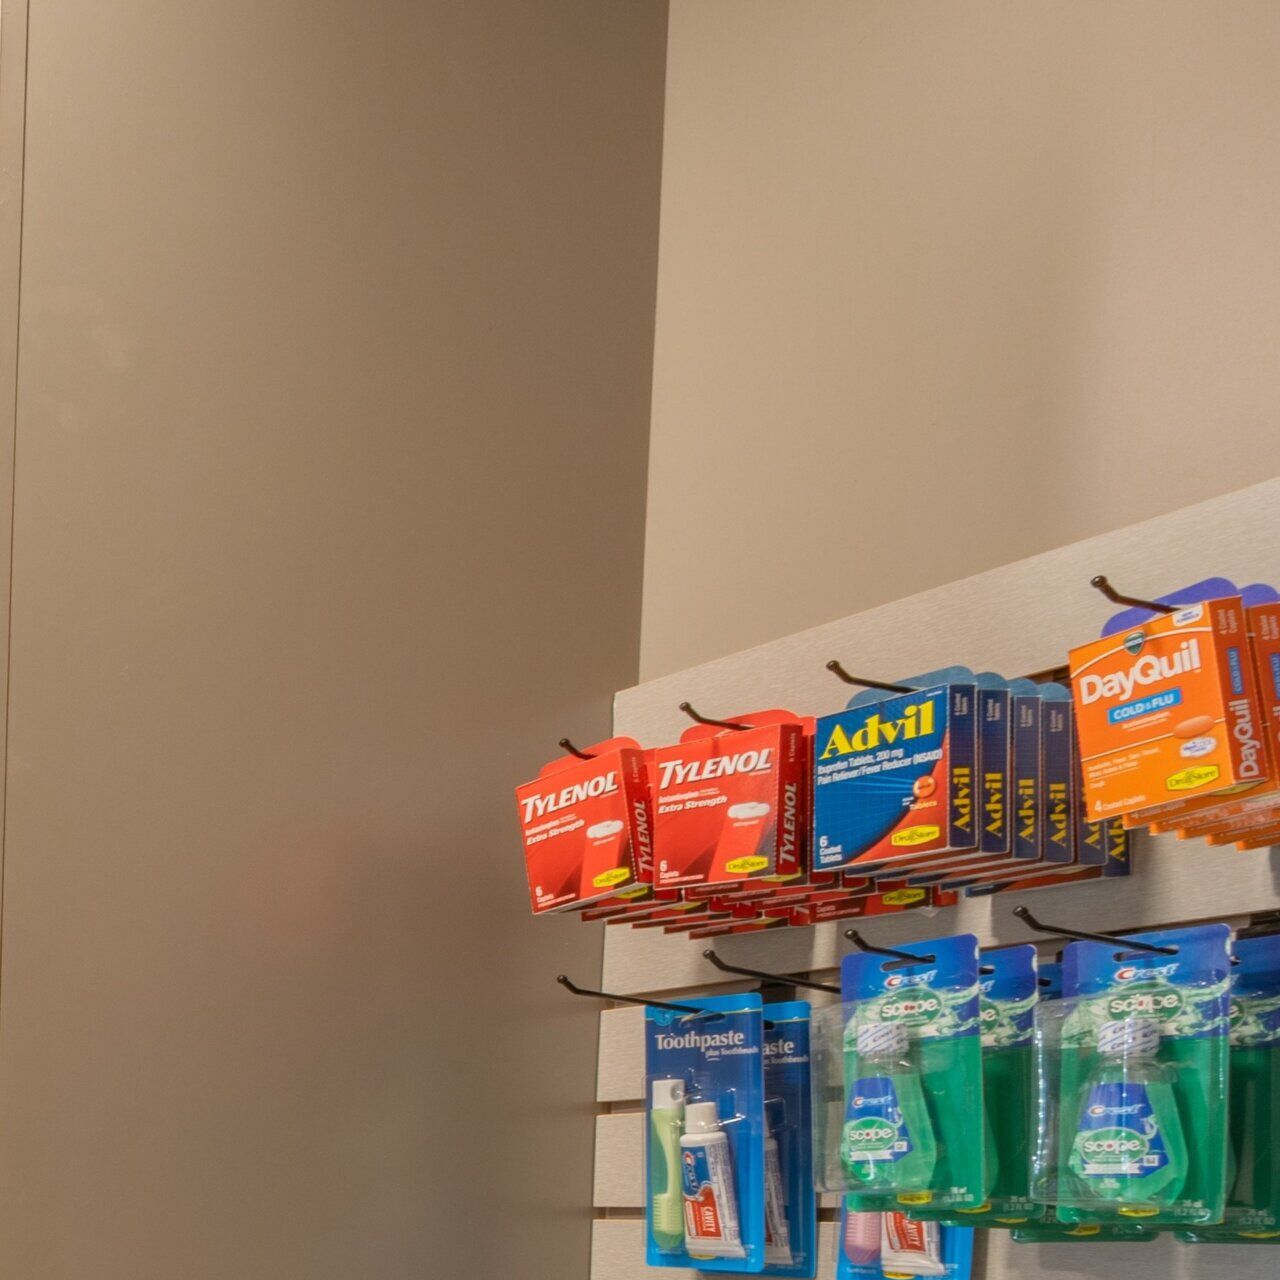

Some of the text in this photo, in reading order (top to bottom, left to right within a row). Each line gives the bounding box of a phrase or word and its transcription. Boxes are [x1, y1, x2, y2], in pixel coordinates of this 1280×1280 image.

[1079, 638, 1202, 706] DayQuil
[819, 700, 935, 760] Advil
[1228, 698, 1260, 778] DayQuil
[658, 747, 775, 790] TYLENOL
[520, 771, 618, 824] TYLENOL
[658, 795, 728, 814] Extra Strength
[953, 767, 971, 833] Advil
[985, 772, 1003, 838] Advil
[1094, 801, 1102, 812] 4
[1018, 778, 1035, 843] Advil
[1049, 783, 1067, 848] Advil
[526, 819, 585, 846] Extra Strength
[779, 783, 797, 864] TYLENOL
[633, 800, 654, 874] TYLENOL
[819, 835, 828, 847] 6
[660, 860, 667, 871] 6
[535, 886, 543, 897] 6
[884, 970, 938, 989] Crest
[1114, 962, 1180, 982] Crest
[880, 998, 939, 1017] scope
[1109, 992, 1181, 1016] scope
[655, 1030, 744, 1052] Toothpaste
[720, 1045, 759, 1056] Toothbrush
[849, 1126, 893, 1142] scope
[1082, 1139, 1142, 1155] scope
[704, 1206, 716, 1233] CAVITY
